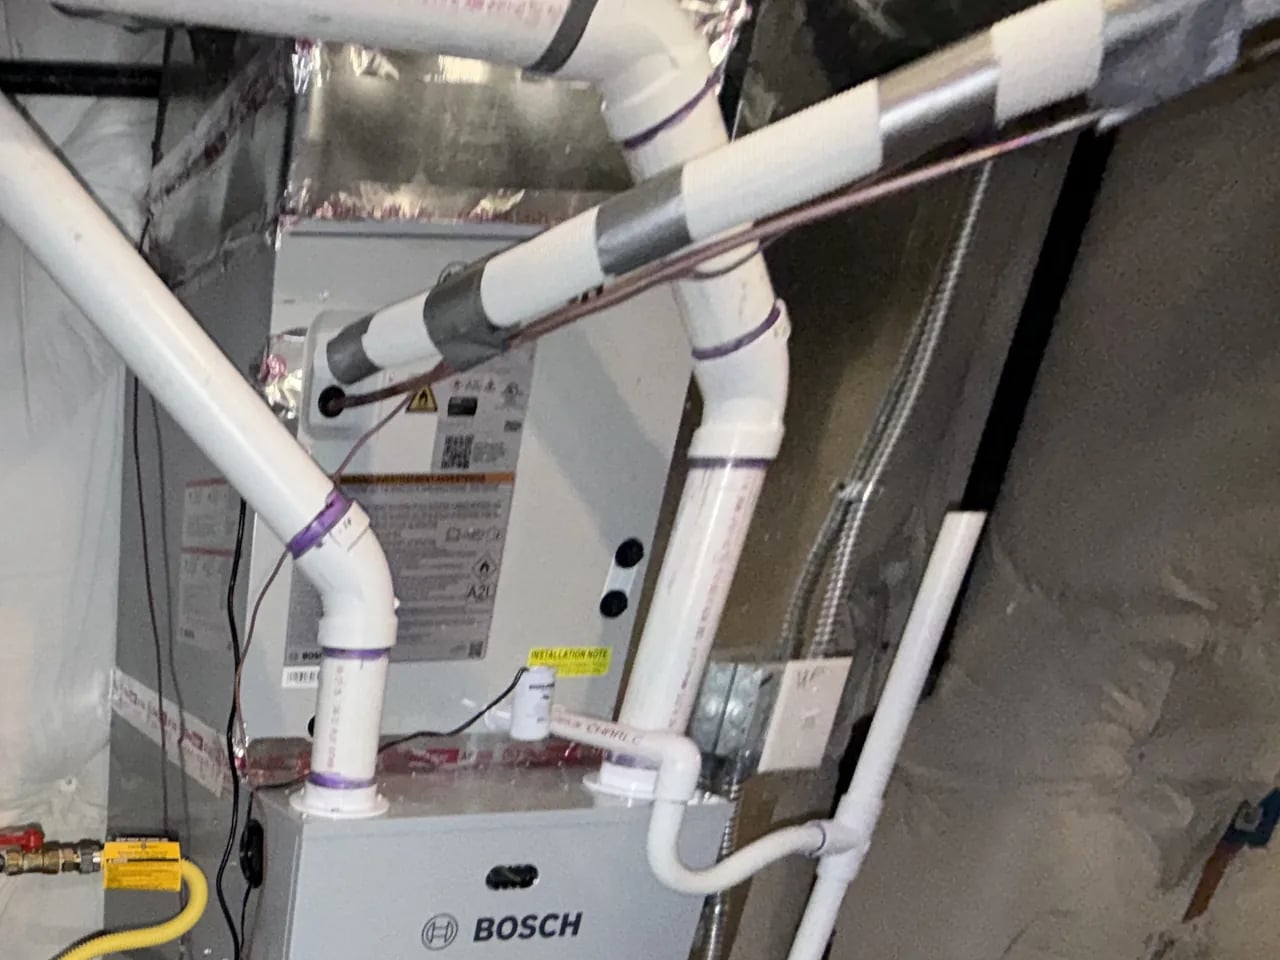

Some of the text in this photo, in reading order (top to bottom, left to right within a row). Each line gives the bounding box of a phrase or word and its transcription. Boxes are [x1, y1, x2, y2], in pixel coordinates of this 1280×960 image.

[531, 647, 609, 660] INSTALLATION NOTE
[473, 911, 583, 943] BOSCH
